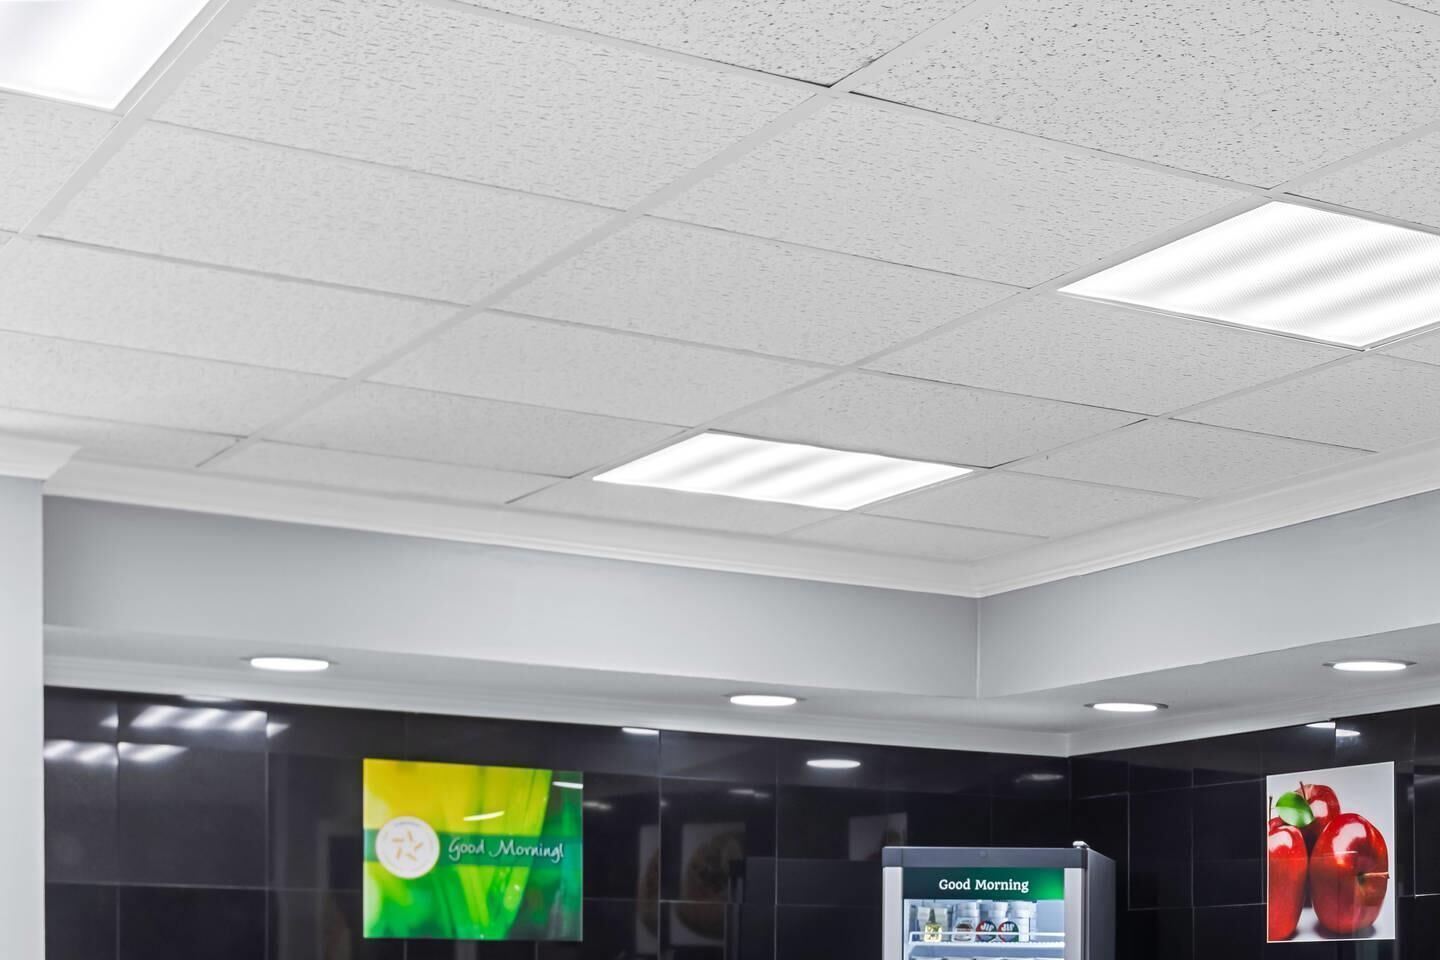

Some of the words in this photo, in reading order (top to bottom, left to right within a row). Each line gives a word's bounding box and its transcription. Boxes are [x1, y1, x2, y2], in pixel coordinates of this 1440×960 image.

[448, 836, 485, 861] Good
[488, 839, 565, 864] Morning!
[938, 878, 972, 891] Good
[974, 878, 1030, 893] Morning
